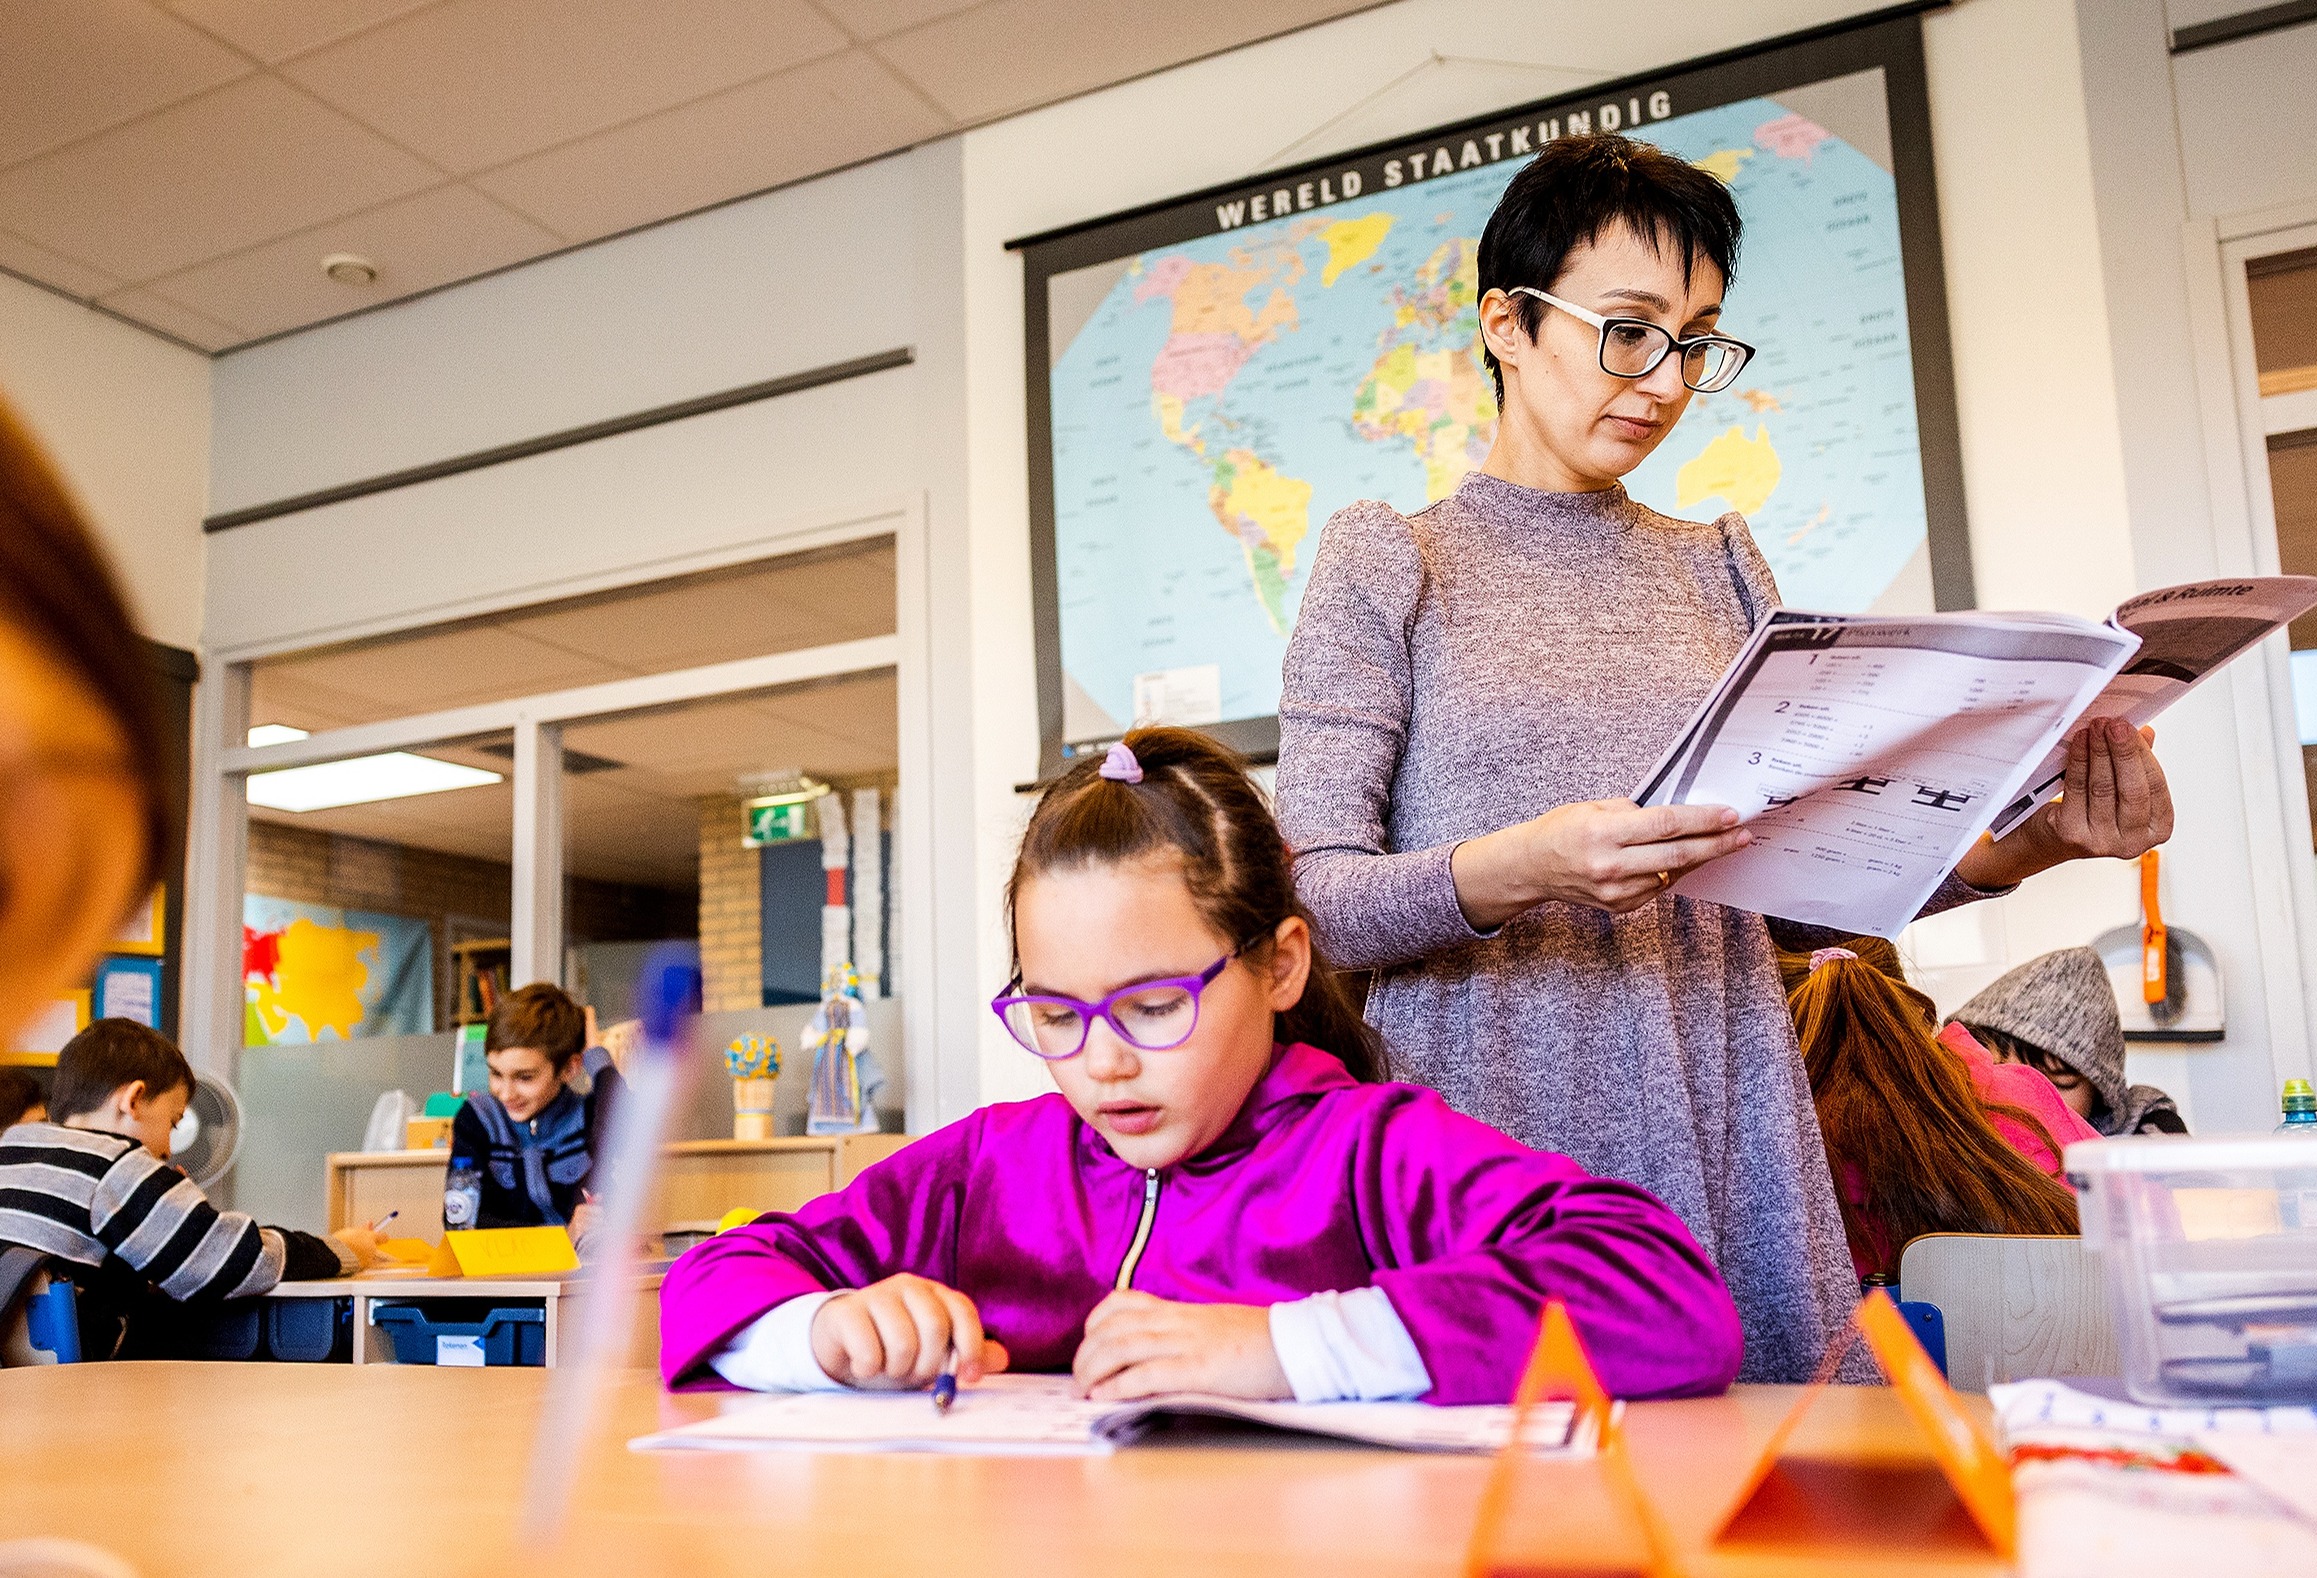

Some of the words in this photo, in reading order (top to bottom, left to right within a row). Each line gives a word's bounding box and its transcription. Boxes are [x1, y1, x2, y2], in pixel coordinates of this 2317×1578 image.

[1216, 171, 1362, 230] WERELD
[1384, 90, 1672, 187] STAATKUNDIG
[2174, 585, 2254, 600] Ruimte
[1808, 653, 1819, 666] 1
[1774, 701, 1791, 714] 2
[1748, 751, 1762, 766] 3
